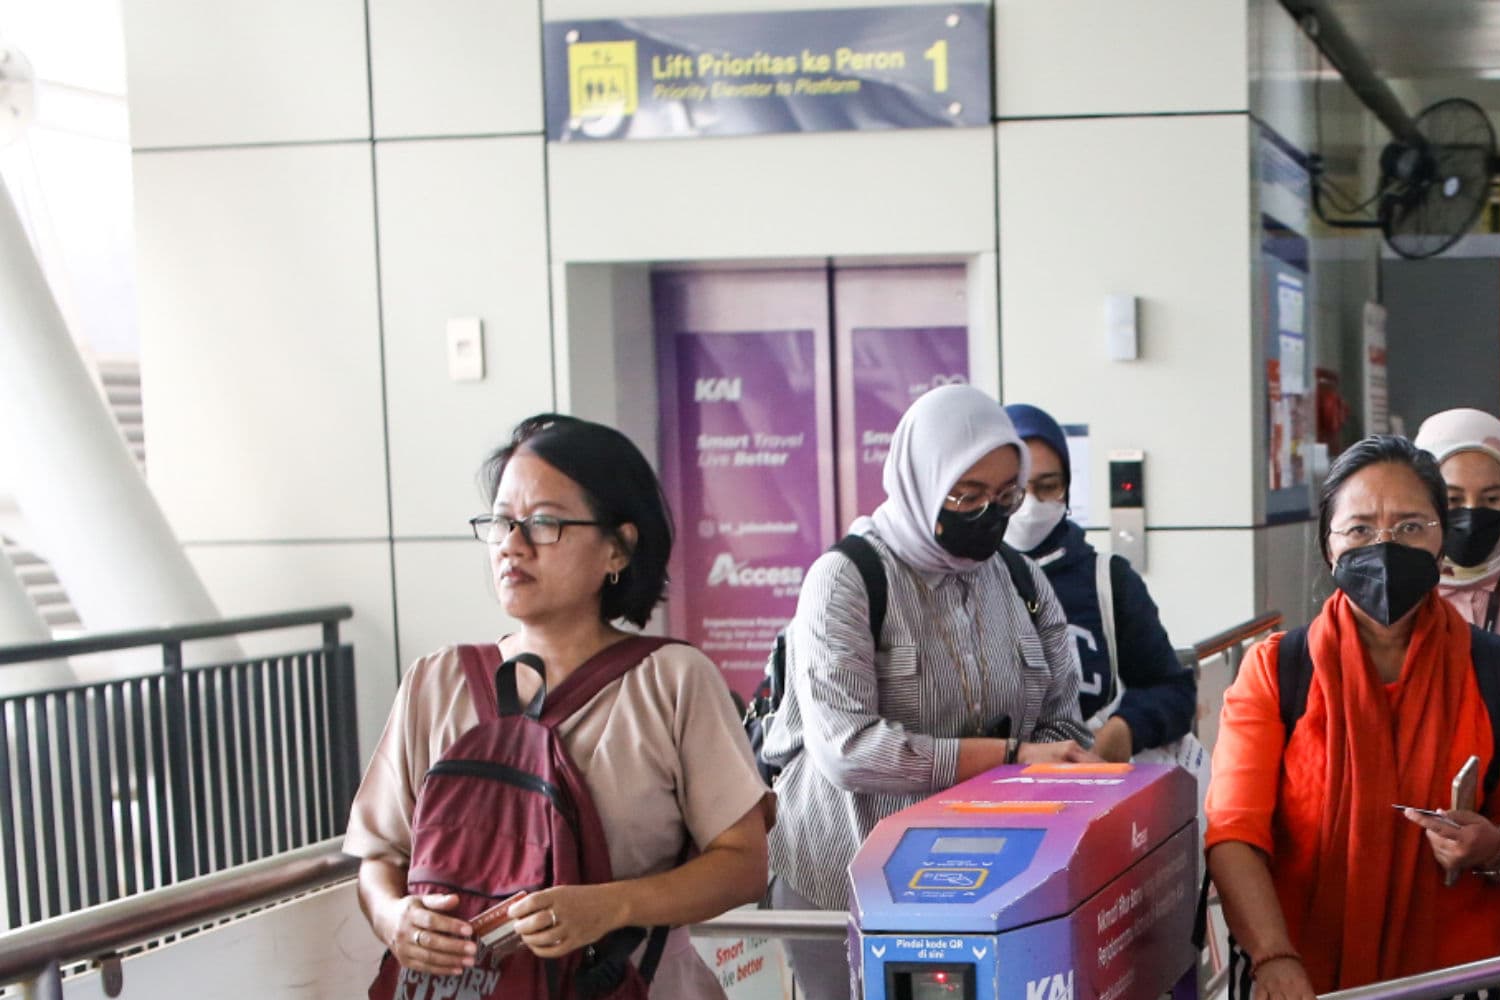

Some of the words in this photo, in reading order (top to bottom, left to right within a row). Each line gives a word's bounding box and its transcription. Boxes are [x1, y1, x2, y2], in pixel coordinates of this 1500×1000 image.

[652, 55, 692, 79] Lift
[697, 50, 797, 77] Prioritas
[801, 49, 830, 73] ke
[835, 47, 905, 70] Peron
[924, 40, 948, 93] 1
[715, 939, 745, 967] Smart
[896, 939, 924, 950] Pindai
[926, 939, 948, 949] kode
[949, 939, 964, 950] QR
[736, 954, 765, 982] better
